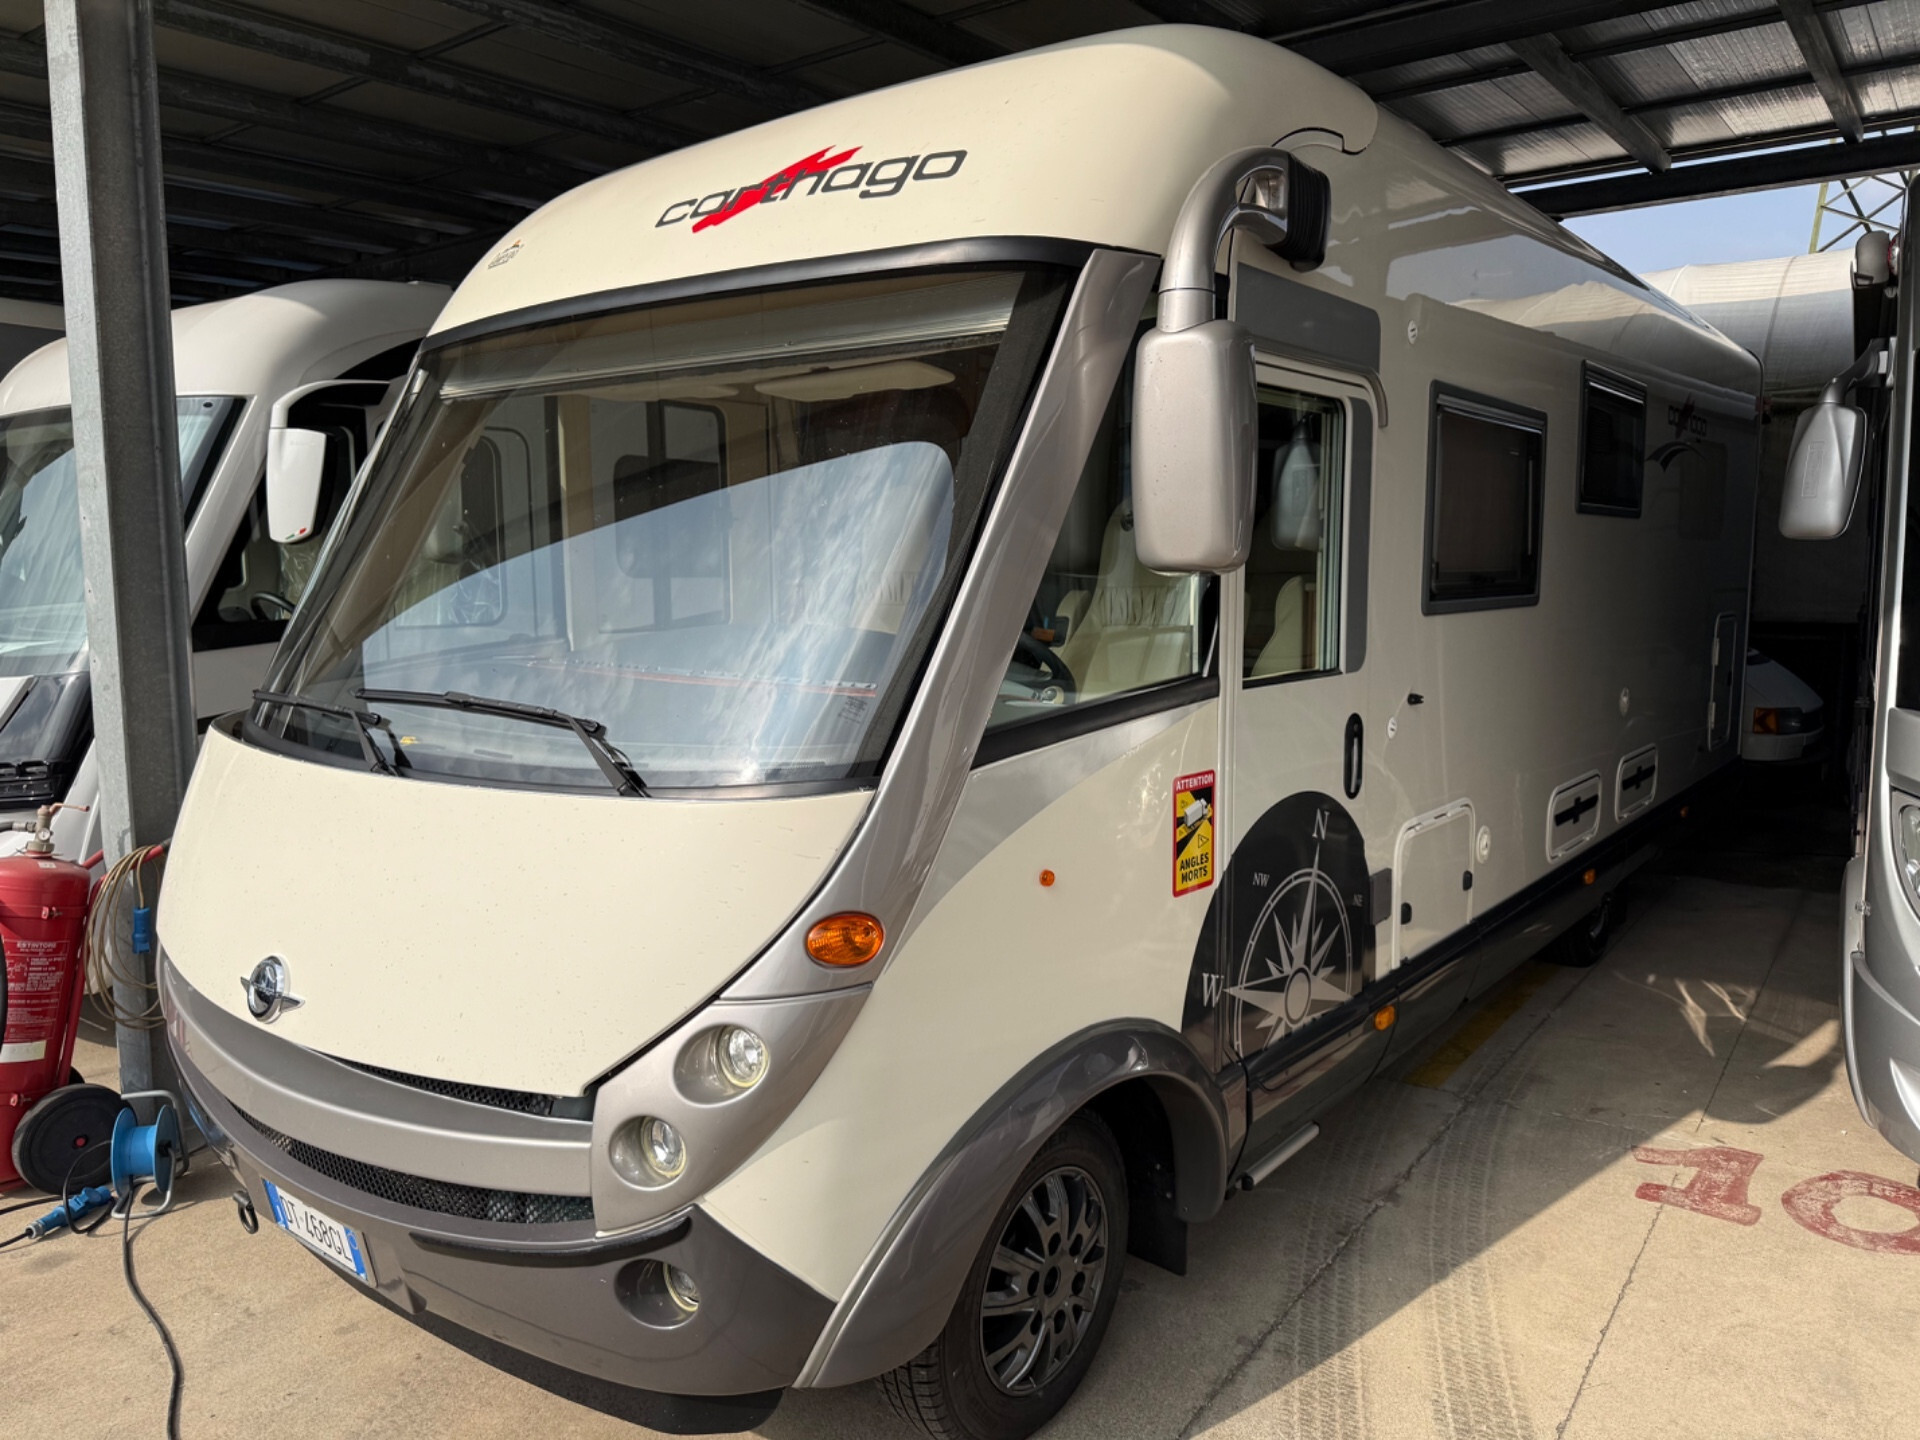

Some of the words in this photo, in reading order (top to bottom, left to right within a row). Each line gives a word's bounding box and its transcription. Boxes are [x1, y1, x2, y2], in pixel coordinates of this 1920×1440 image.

[654, 149, 968, 228] carthago
[1176, 774, 1213, 791] ATTENTION
[1313, 809, 1331, 840] N
[1180, 852, 1209, 871] ANGLES
[1181, 865, 1208, 883] MORTS
[1252, 872, 1270, 887] NW
[1201, 973, 1224, 1008] W
